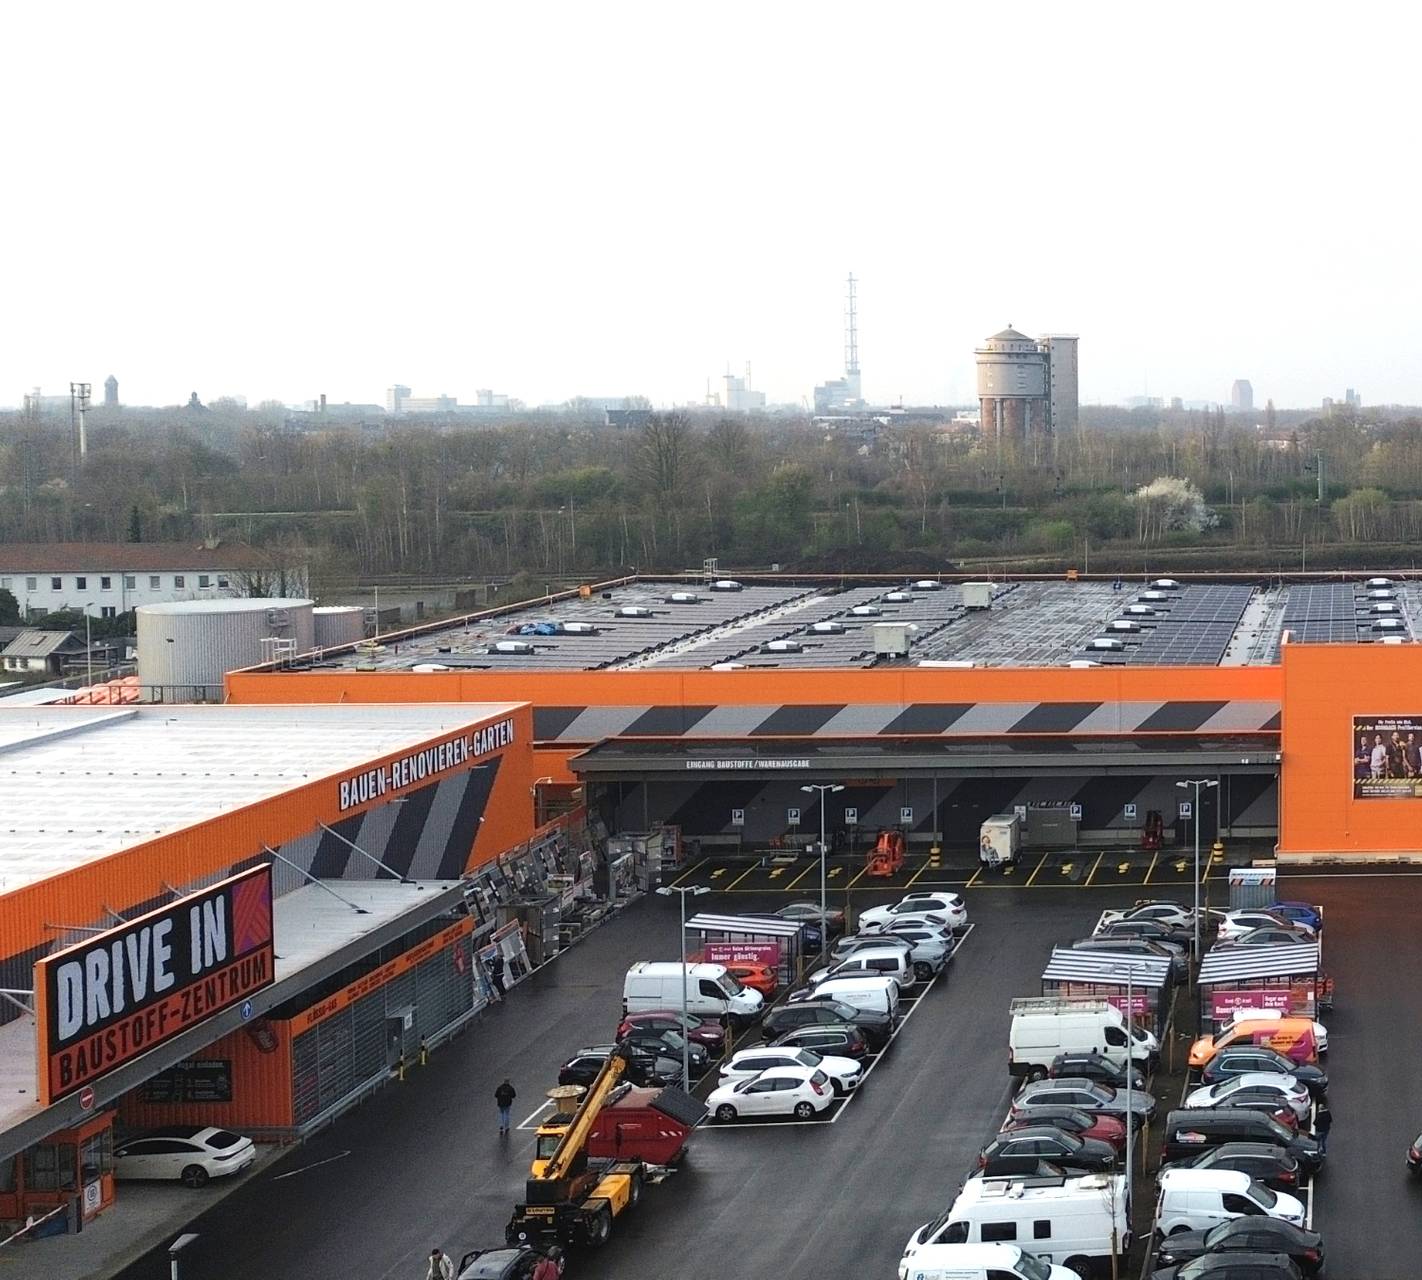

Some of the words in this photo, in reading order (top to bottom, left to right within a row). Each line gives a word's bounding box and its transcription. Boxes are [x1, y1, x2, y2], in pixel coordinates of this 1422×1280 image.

[338, 717, 515, 812] BAUEN-RENOVIEREN-GARTEN
[686, 760, 715, 769] EINGANG
[56, 918, 175, 1041] DRIVE
[190, 894, 227, 976] IN
[59, 952, 267, 1089] BAUSTOFF-ZENTRUM
